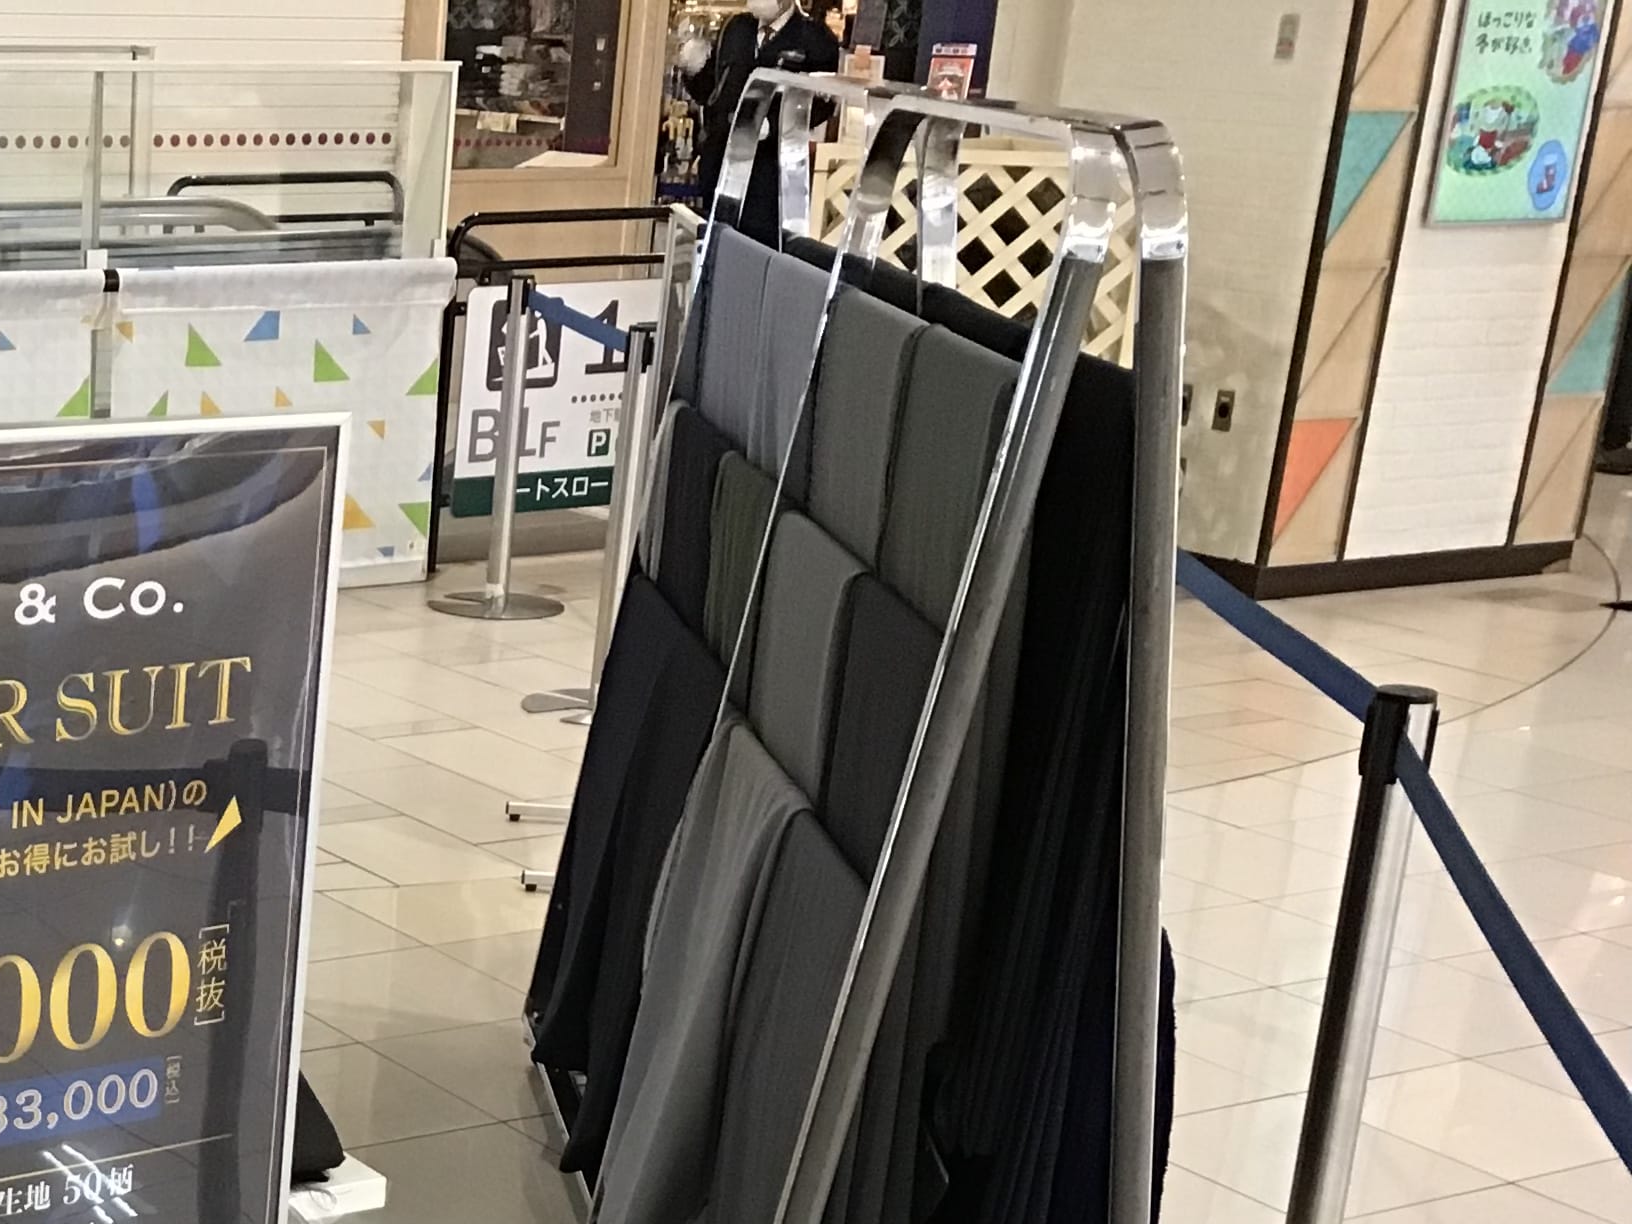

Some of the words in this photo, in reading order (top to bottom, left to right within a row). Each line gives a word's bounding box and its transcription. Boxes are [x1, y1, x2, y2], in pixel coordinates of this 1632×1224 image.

[590, 431, 608, 455] P
[515, 476, 609, 502] ートスロー
[14, 583, 57, 626] &
[56, 656, 252, 742] SUIT
[11, 798, 44, 830] IN
